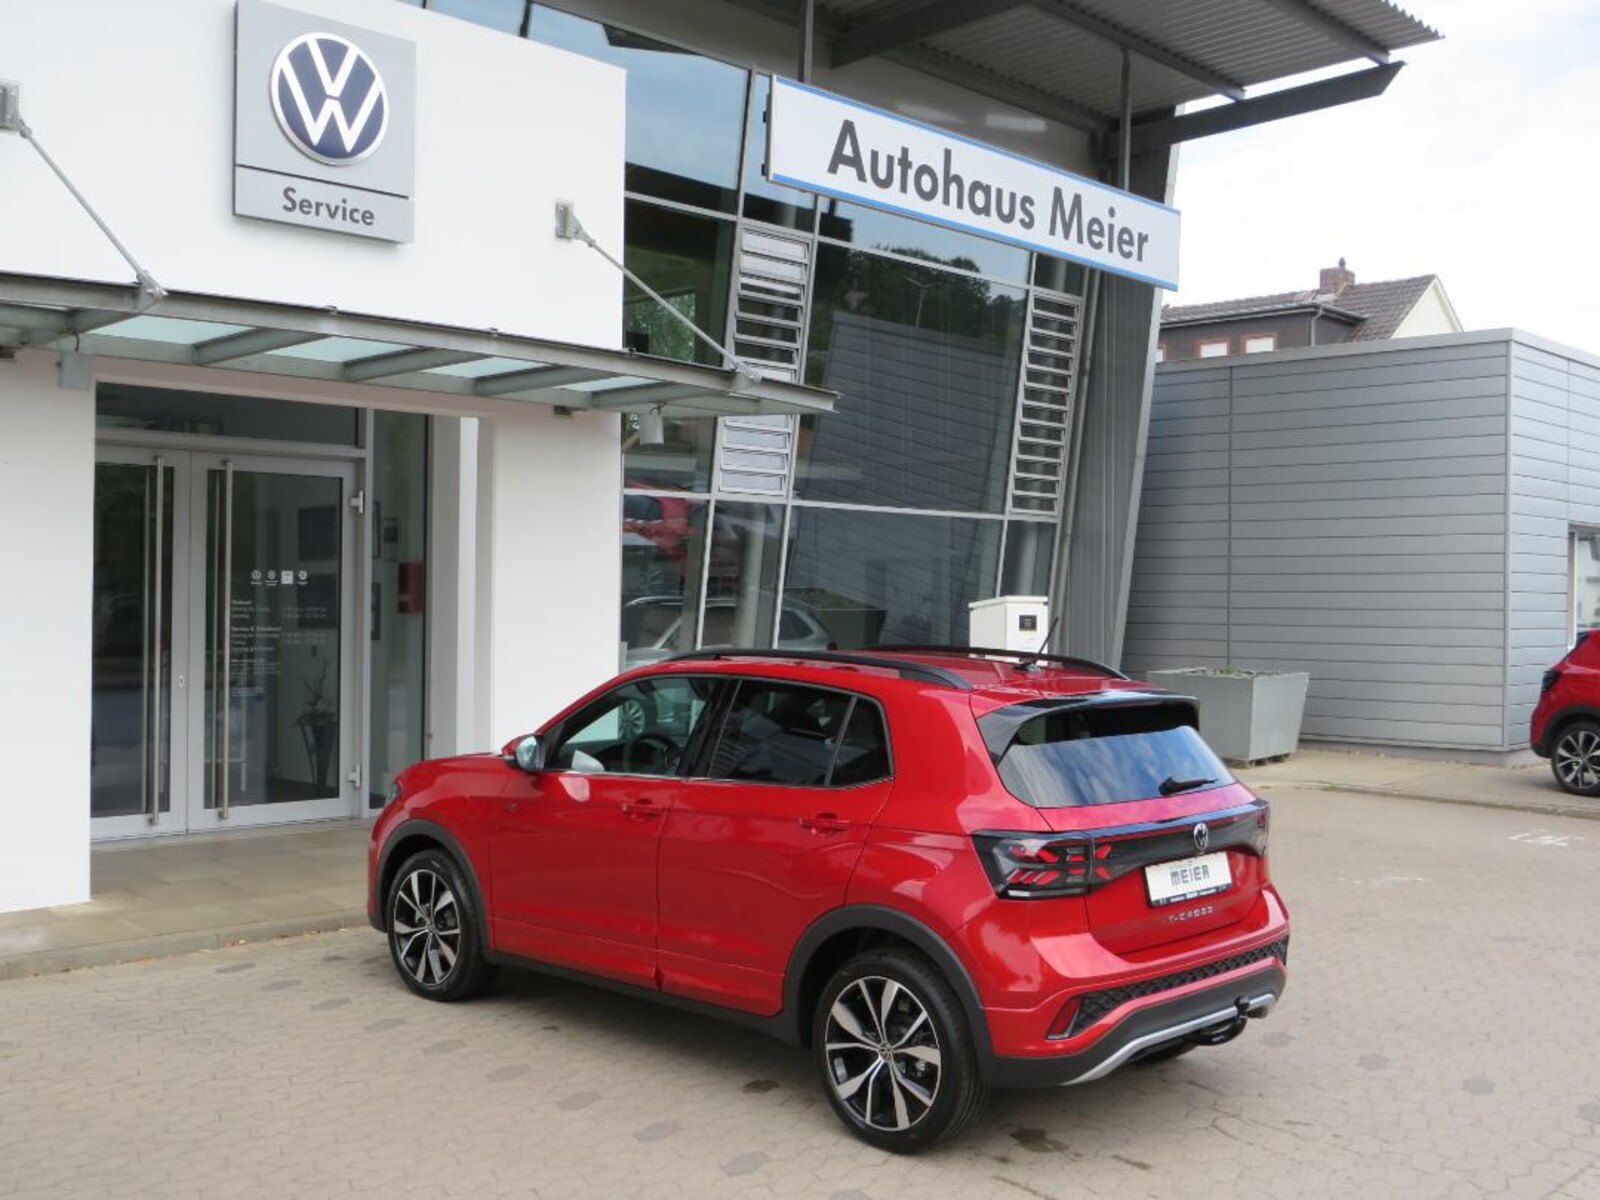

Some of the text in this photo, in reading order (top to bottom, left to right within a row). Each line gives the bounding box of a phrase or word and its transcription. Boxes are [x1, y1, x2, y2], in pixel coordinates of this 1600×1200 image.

[282, 186, 375, 227] Service
[827, 118, 1149, 263] Autohaus Meier
[1170, 864, 1210, 886] MEIER
